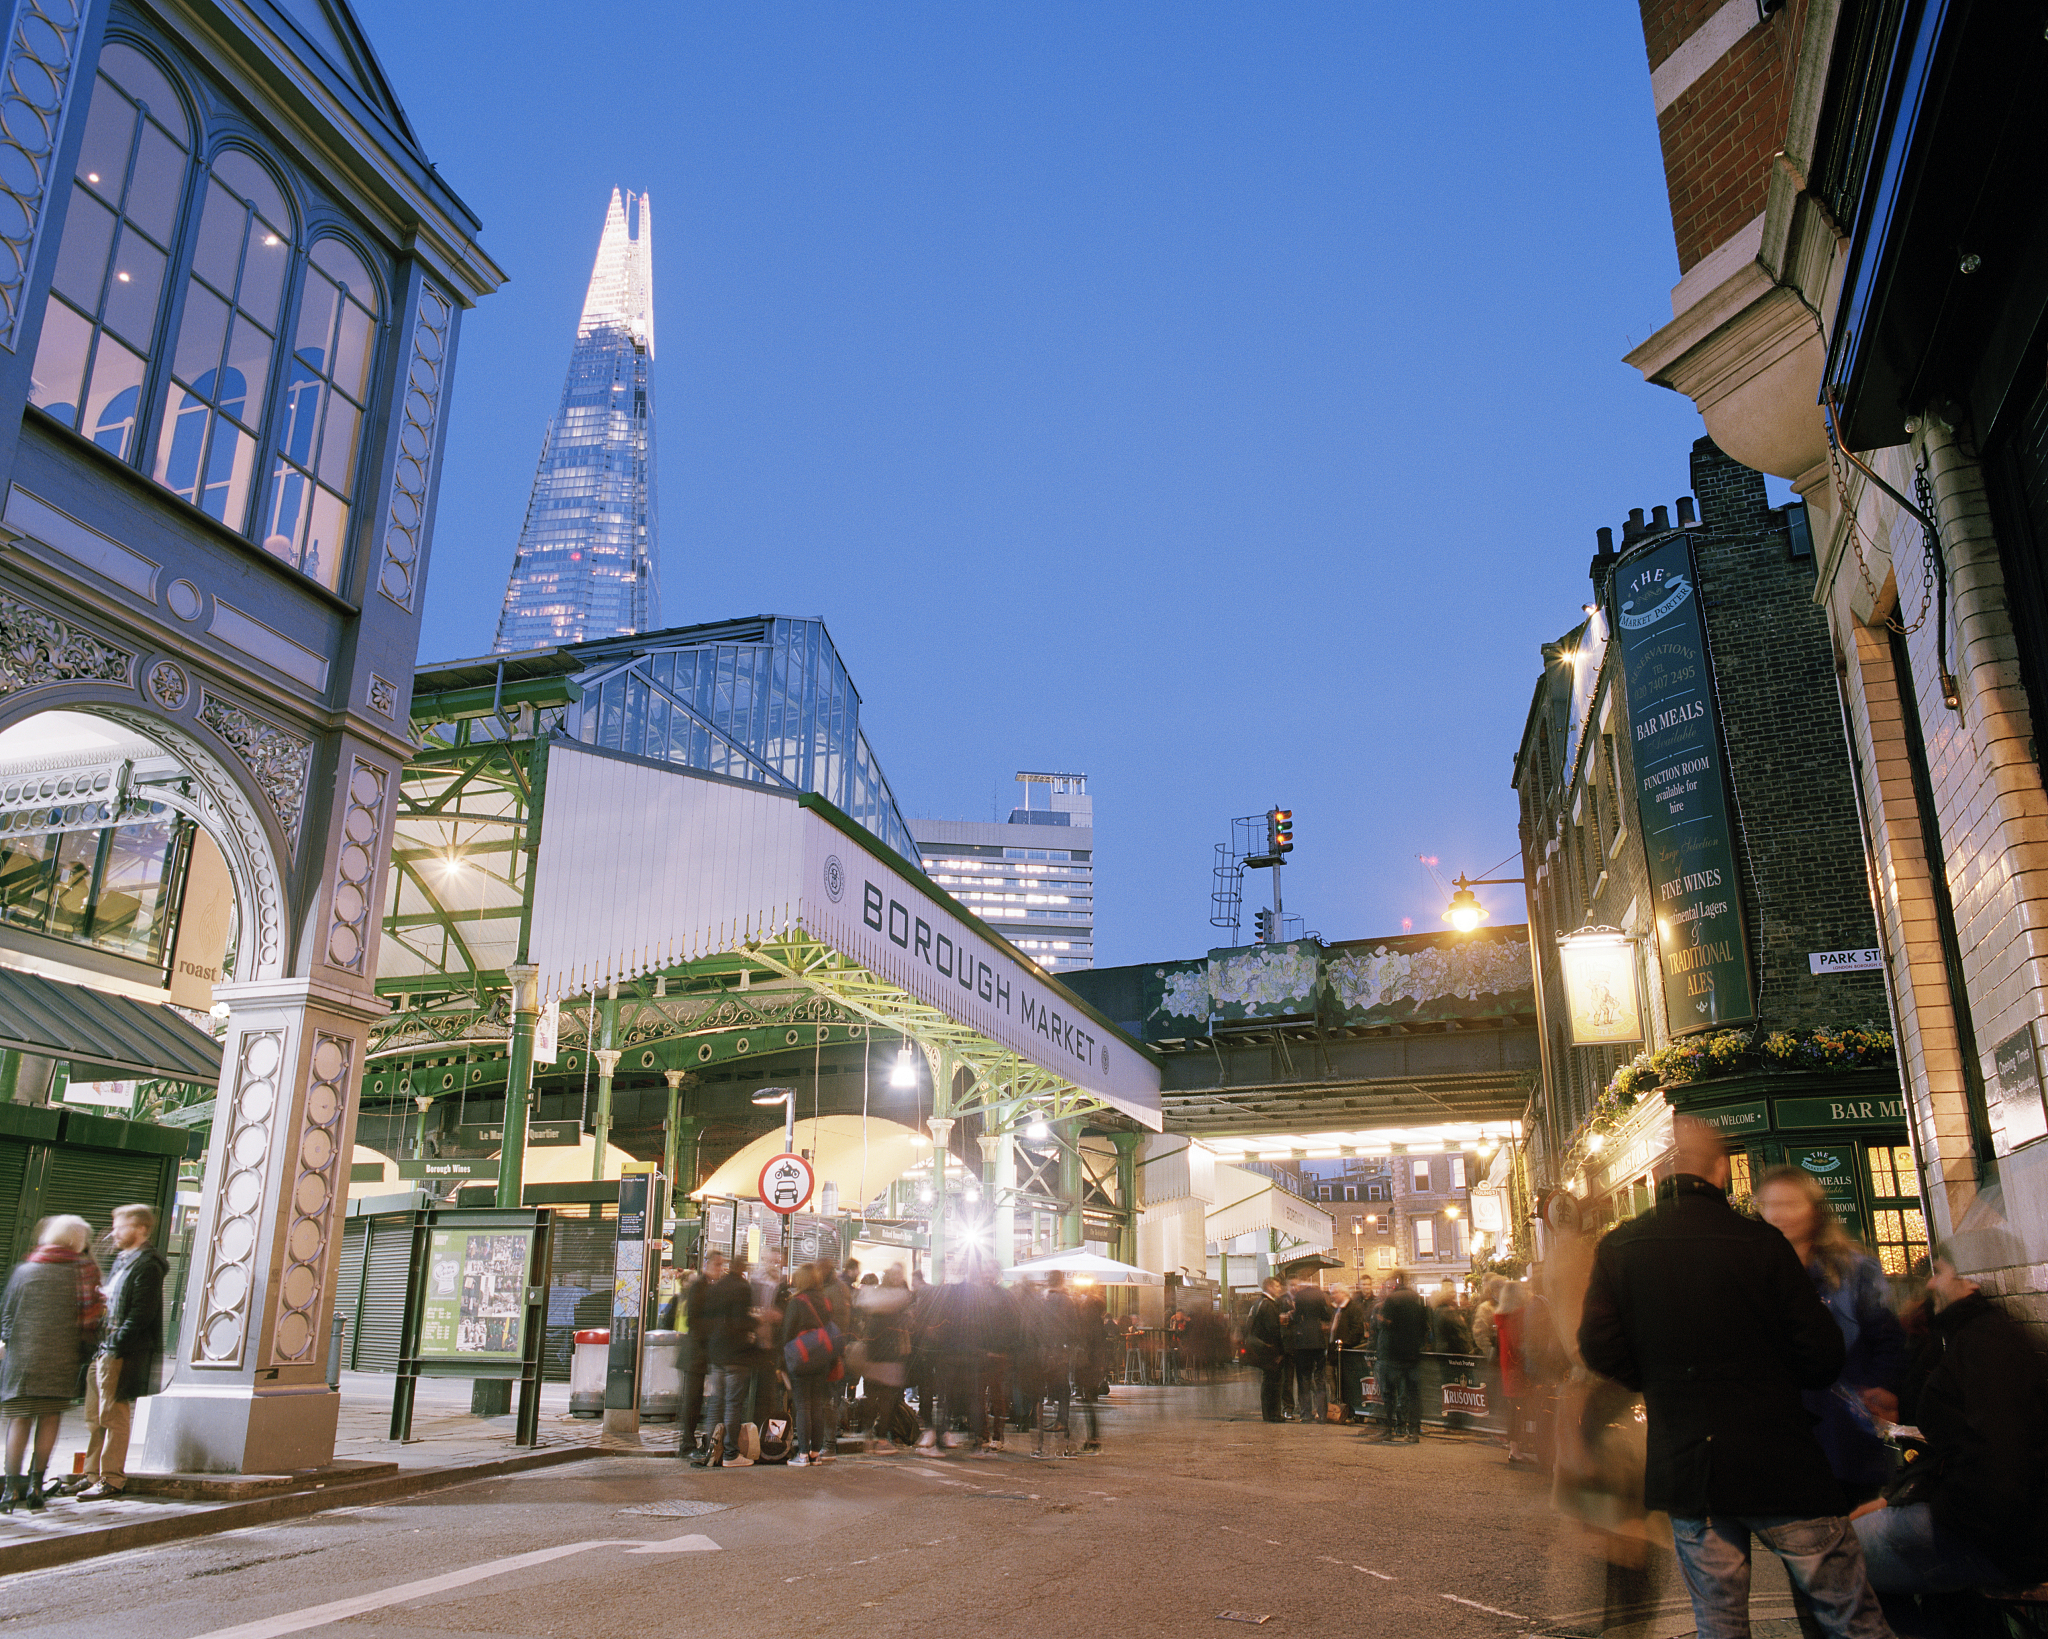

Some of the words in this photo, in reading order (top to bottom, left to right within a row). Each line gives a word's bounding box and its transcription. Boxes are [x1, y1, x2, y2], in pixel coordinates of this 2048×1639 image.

[1630, 568, 1665, 593] THE
[1621, 613, 1652, 627] MARKET
[1654, 588, 1690, 618] PORTER
[1631, 643, 1697, 684] RESERVATIONS
[1652, 663, 1665, 676] TEL
[1648, 675, 1669, 694] 7407
[1670, 665, 1696, 684] 2495
[1636, 717, 1659, 741] BAR
[1658, 700, 1704, 731] MEALS
[1643, 764, 1681, 791] FUNCTION
[1681, 756, 1710, 776] ROOM
[1655, 782, 1685, 803] available
[1685, 779, 1698, 792] for
[1669, 801, 1685, 814] hire
[1661, 878, 1683, 902] FINE
[1683, 868, 1722, 893] WINES
[1662, 902, 1700, 927] ntinental
[1699, 901, 1728, 919] Lagers
[1668, 940, 1734, 975] TRADITIONAL
[1820, 952, 1857, 965] PARK
[1864, 950, 1881, 962] ST
[179, 960, 218, 982] roast
[863, 879, 1010, 1015] BOROUGH
[1021, 990, 1095, 1066] MARKET
[1687, 970, 1715, 997] ALES
[1697, 1117, 1720, 1129] WARM
[1720, 1112, 1756, 1126] WELCOME
[1829, 1102, 1875, 1120] BAR
[479, 1130, 489, 1141] Le
[528, 1128, 561, 1141] Quartier
[1810, 1151, 1829, 1159] THE
[425, 1164, 451, 1175] Borough
[452, 1164, 471, 1174] Wines
[1818, 1175, 1852, 1186] MEALS
[1834, 1202, 1856, 1213] ROOM
[1838, 1214, 1848, 1224] for
[1443, 1388, 1486, 1407] KRUŠOVICE
